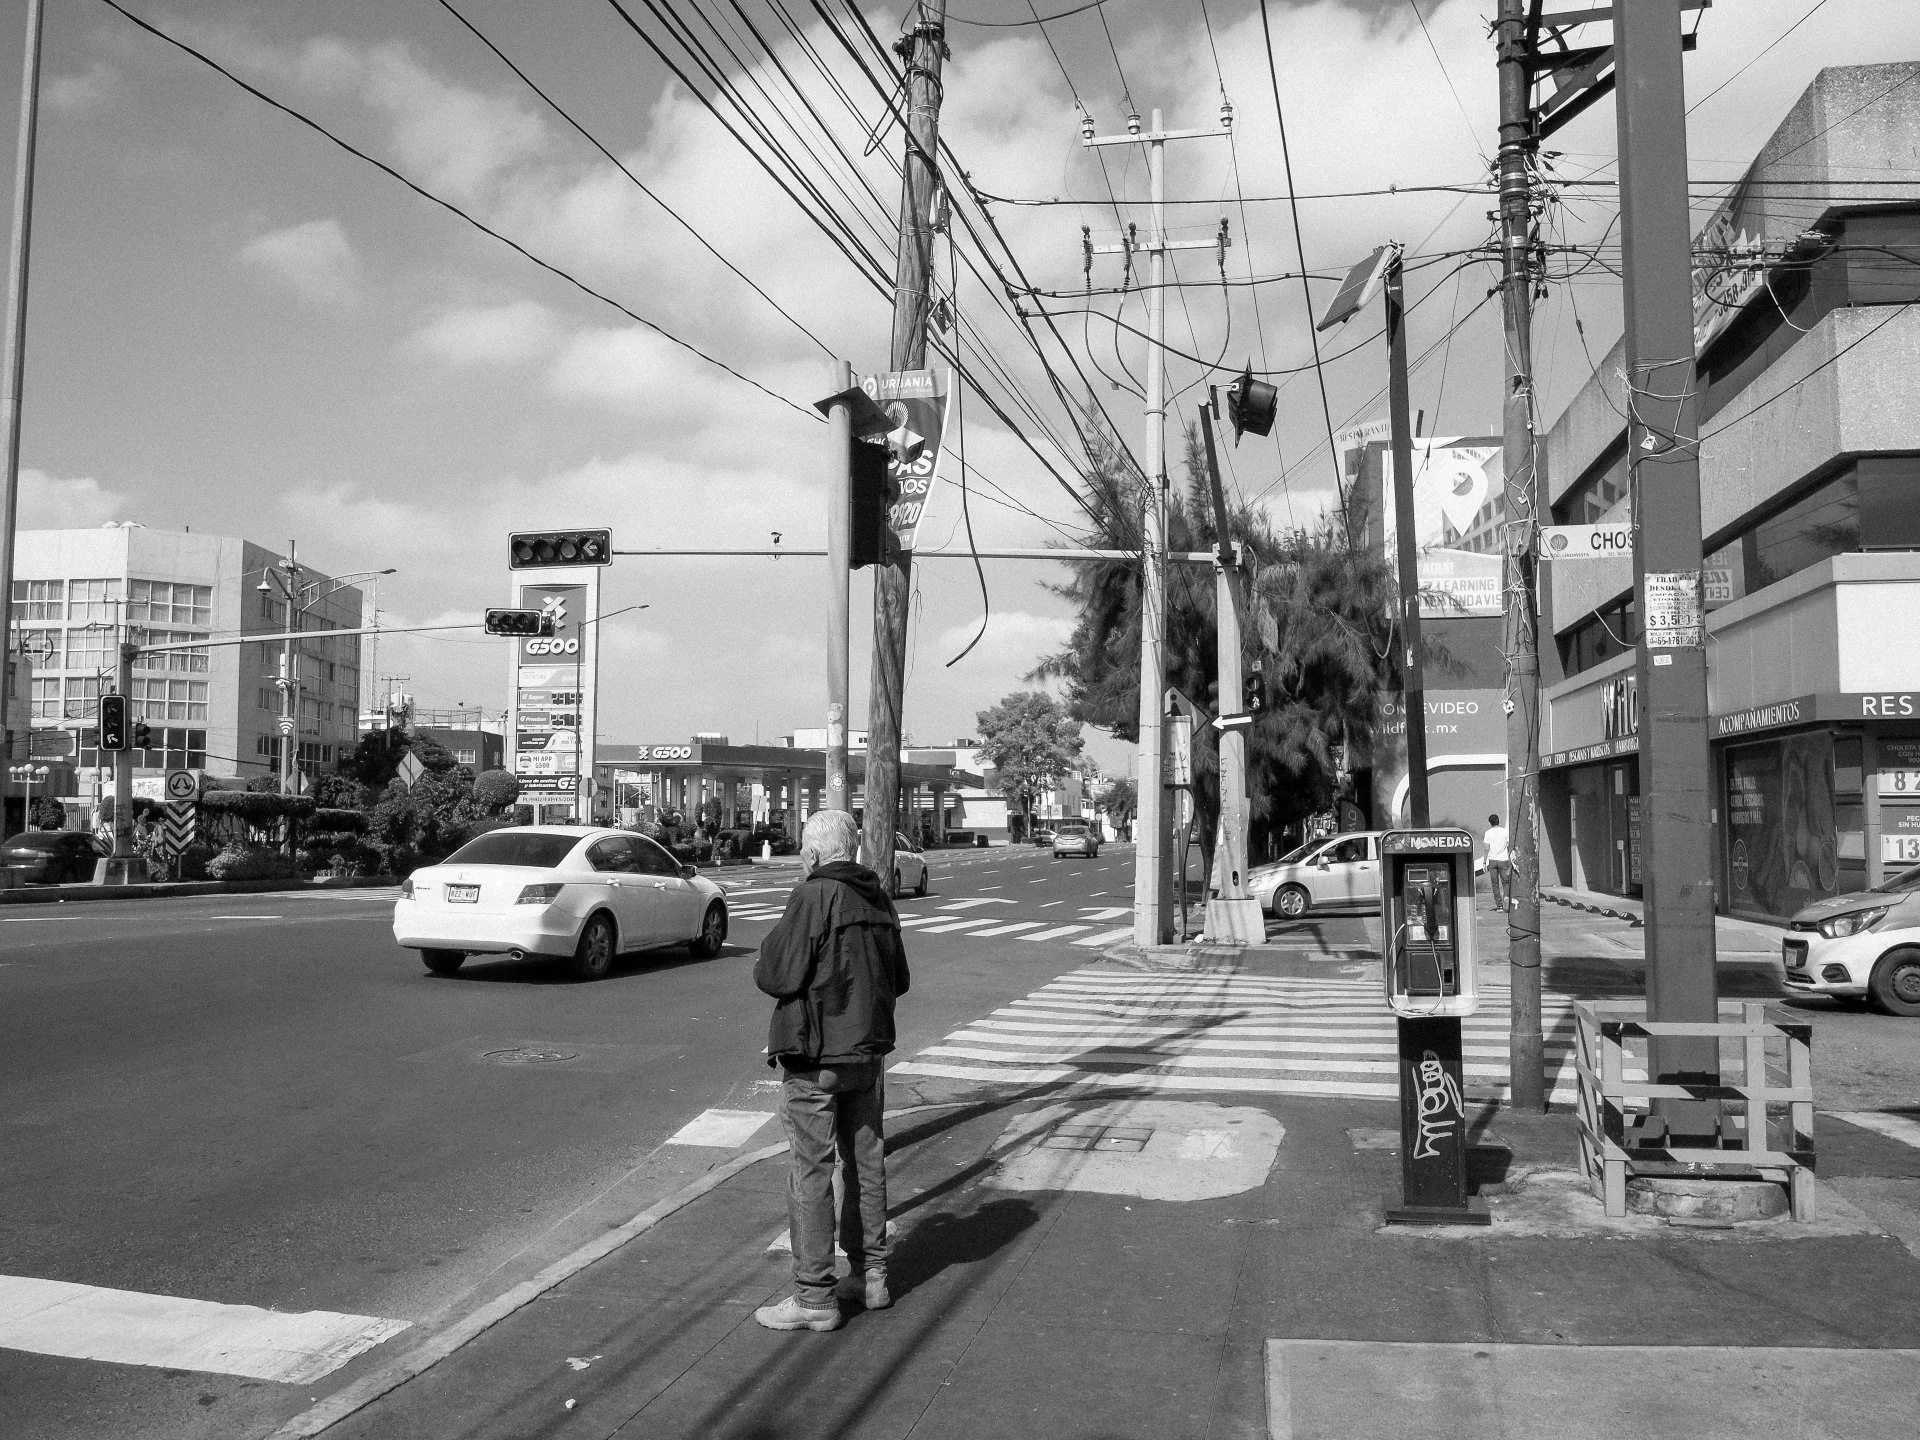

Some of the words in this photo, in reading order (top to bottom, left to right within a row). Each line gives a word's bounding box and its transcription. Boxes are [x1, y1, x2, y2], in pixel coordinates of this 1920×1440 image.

[881, 376, 932, 390] URBANIA
[525, 638, 579, 655] G500
[1862, 695, 1914, 716] RES
[1718, 702, 1800, 735] ACOMPAÑAMIENTOS
[652, 746, 692, 759] G500
[1410, 836, 1469, 849] MONEDAS
